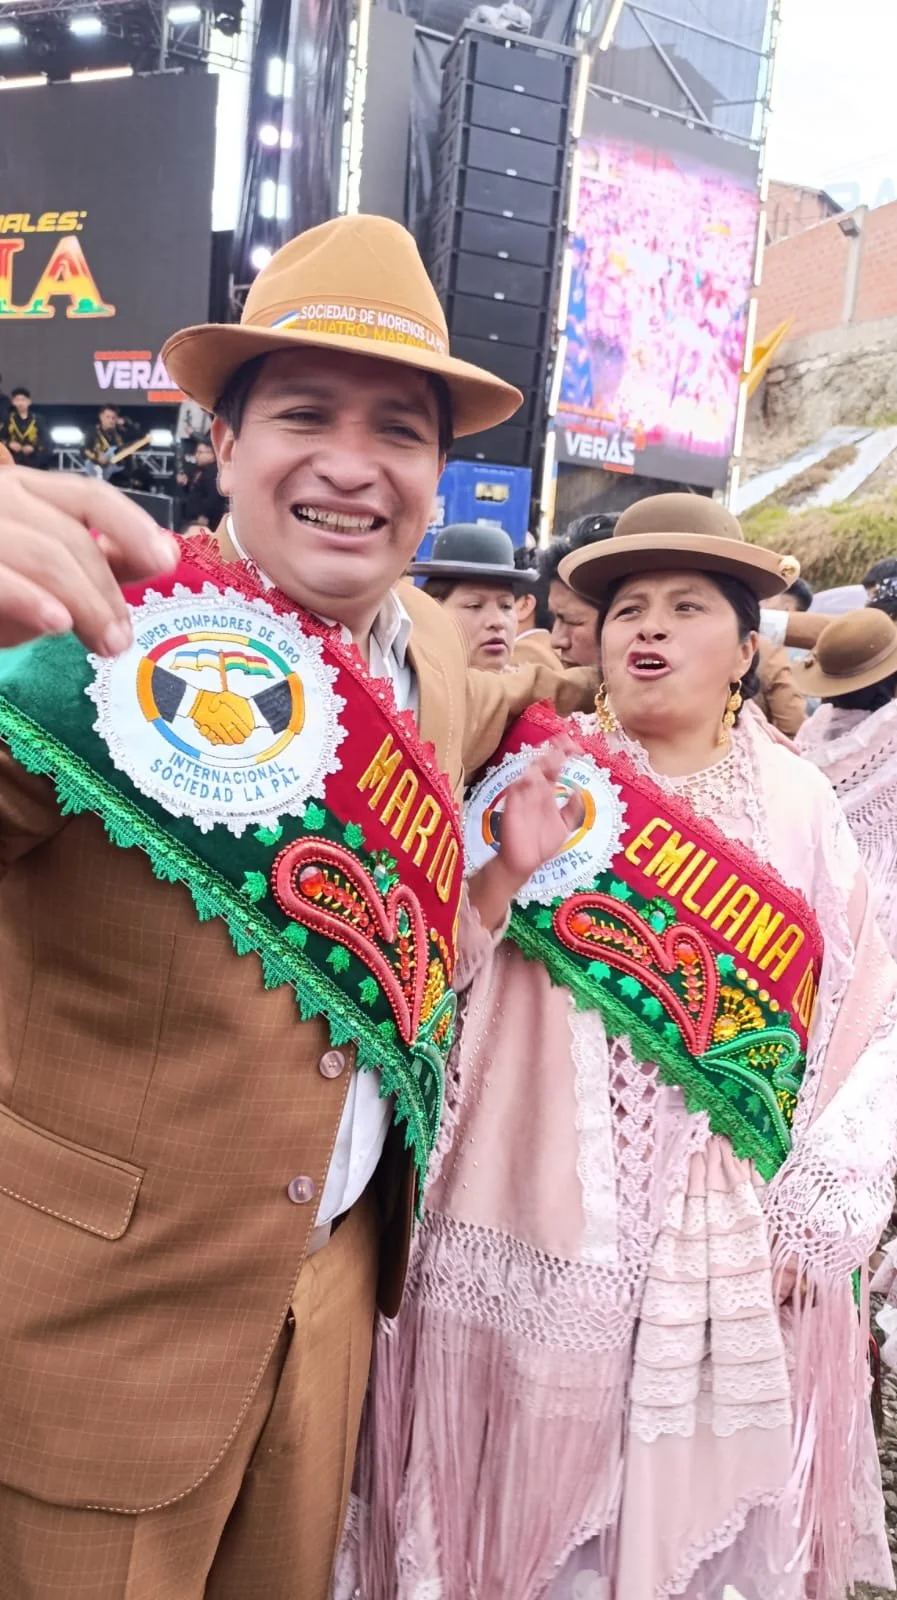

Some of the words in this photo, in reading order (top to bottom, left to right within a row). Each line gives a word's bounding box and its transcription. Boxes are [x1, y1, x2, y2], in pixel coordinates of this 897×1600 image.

[0, 211, 88, 233] ALES:
[300, 304, 356, 321] SOCIEDAD
[359, 310, 375, 325] DE
[377, 311, 425, 340] MORENOS
[306, 319, 368, 338] CUATRO
[94, 353, 180, 389] VERÁ
[136, 624, 169, 650] SUPER
[174, 614, 253, 632] COMPADRES
[258, 626, 275, 642] DE
[277, 640, 300, 664] ORO
[150, 759, 233, 802] SOCIEDAD
[244, 786, 264, 802] LA
[272, 768, 300, 798] PAZ
[169, 752, 285, 784] INTERNACIONAL
[572, 771, 591, 785] ORO
[356, 732, 459, 903] MARIO
[552, 867, 567, 880] LA
[570, 850, 593, 870] PAZ
[624, 817, 805, 982] EMILIANA
